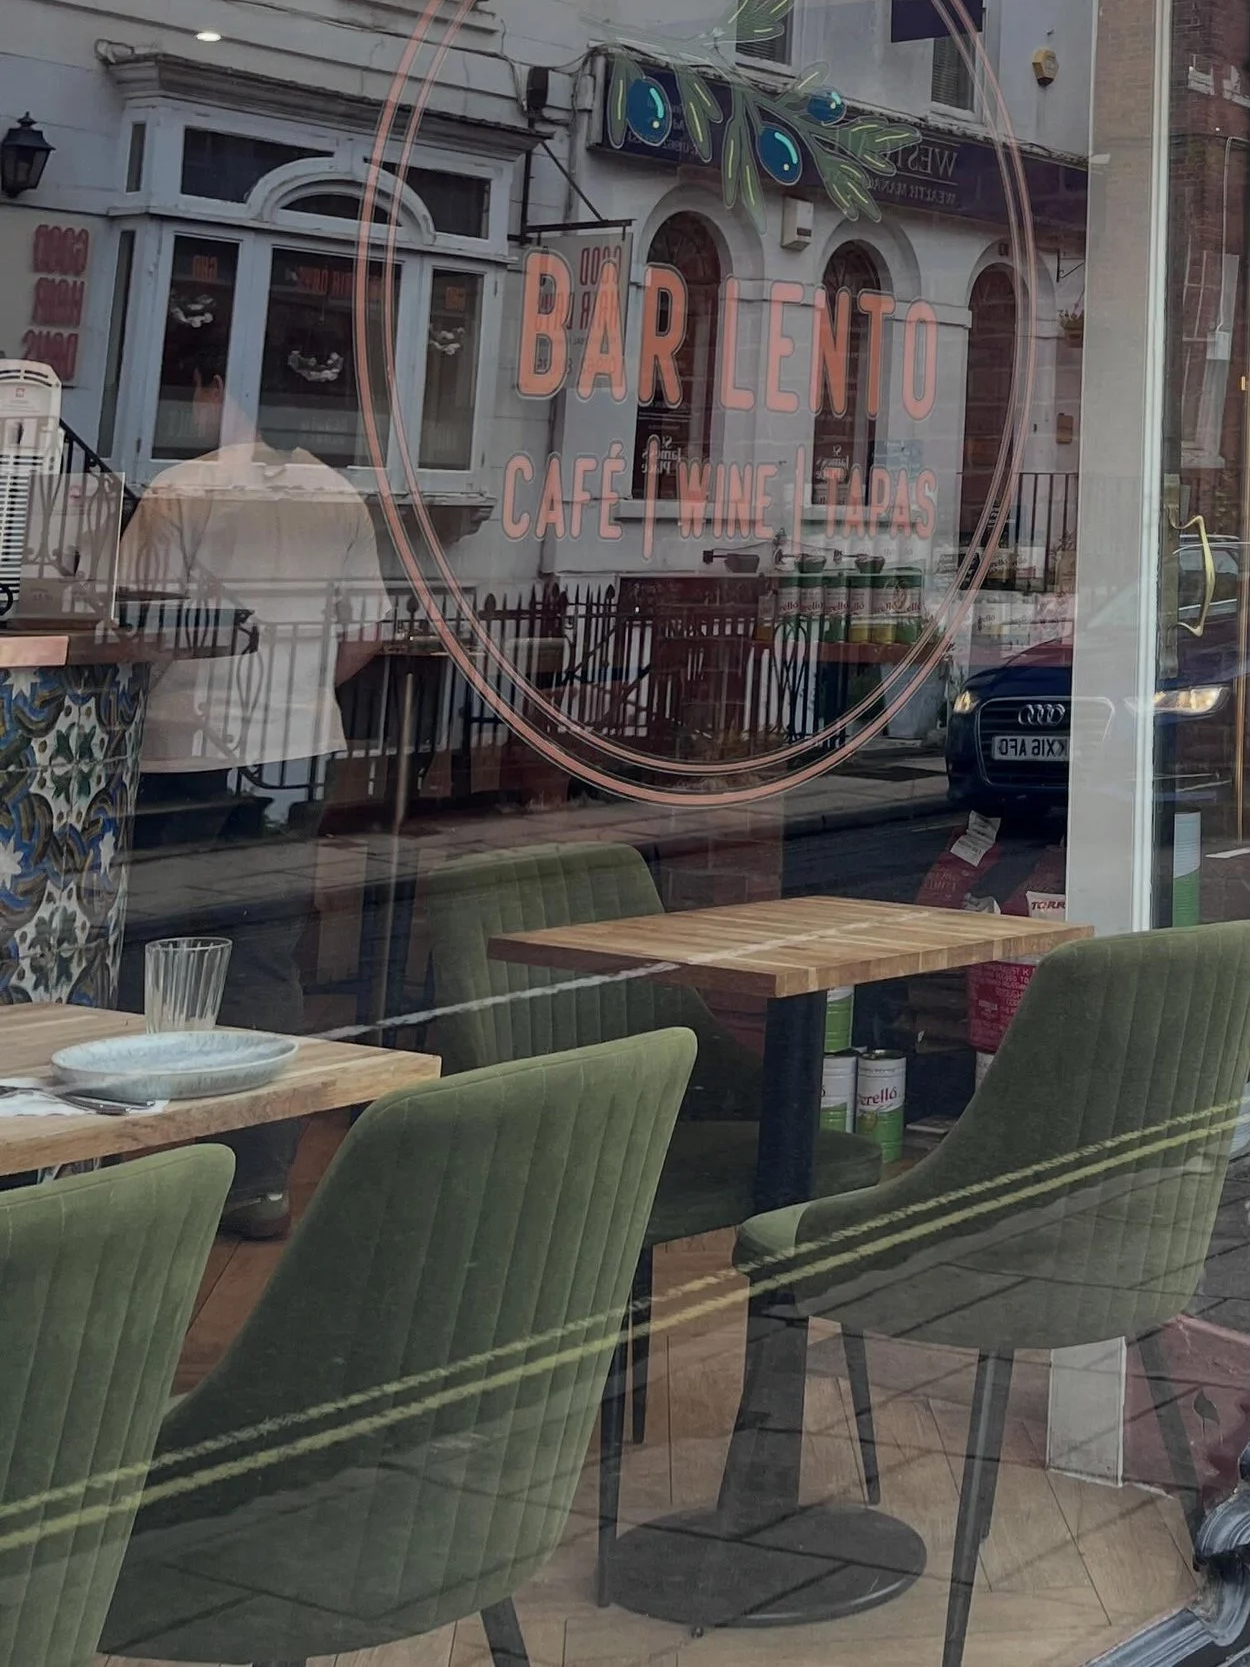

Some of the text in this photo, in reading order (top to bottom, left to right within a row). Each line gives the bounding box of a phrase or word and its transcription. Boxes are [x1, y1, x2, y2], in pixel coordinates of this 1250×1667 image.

[518, 248, 688, 406] BAR
[717, 277, 938, 422] LENTO
[502, 442, 937, 541] CAFÉ WINE TAPAS
